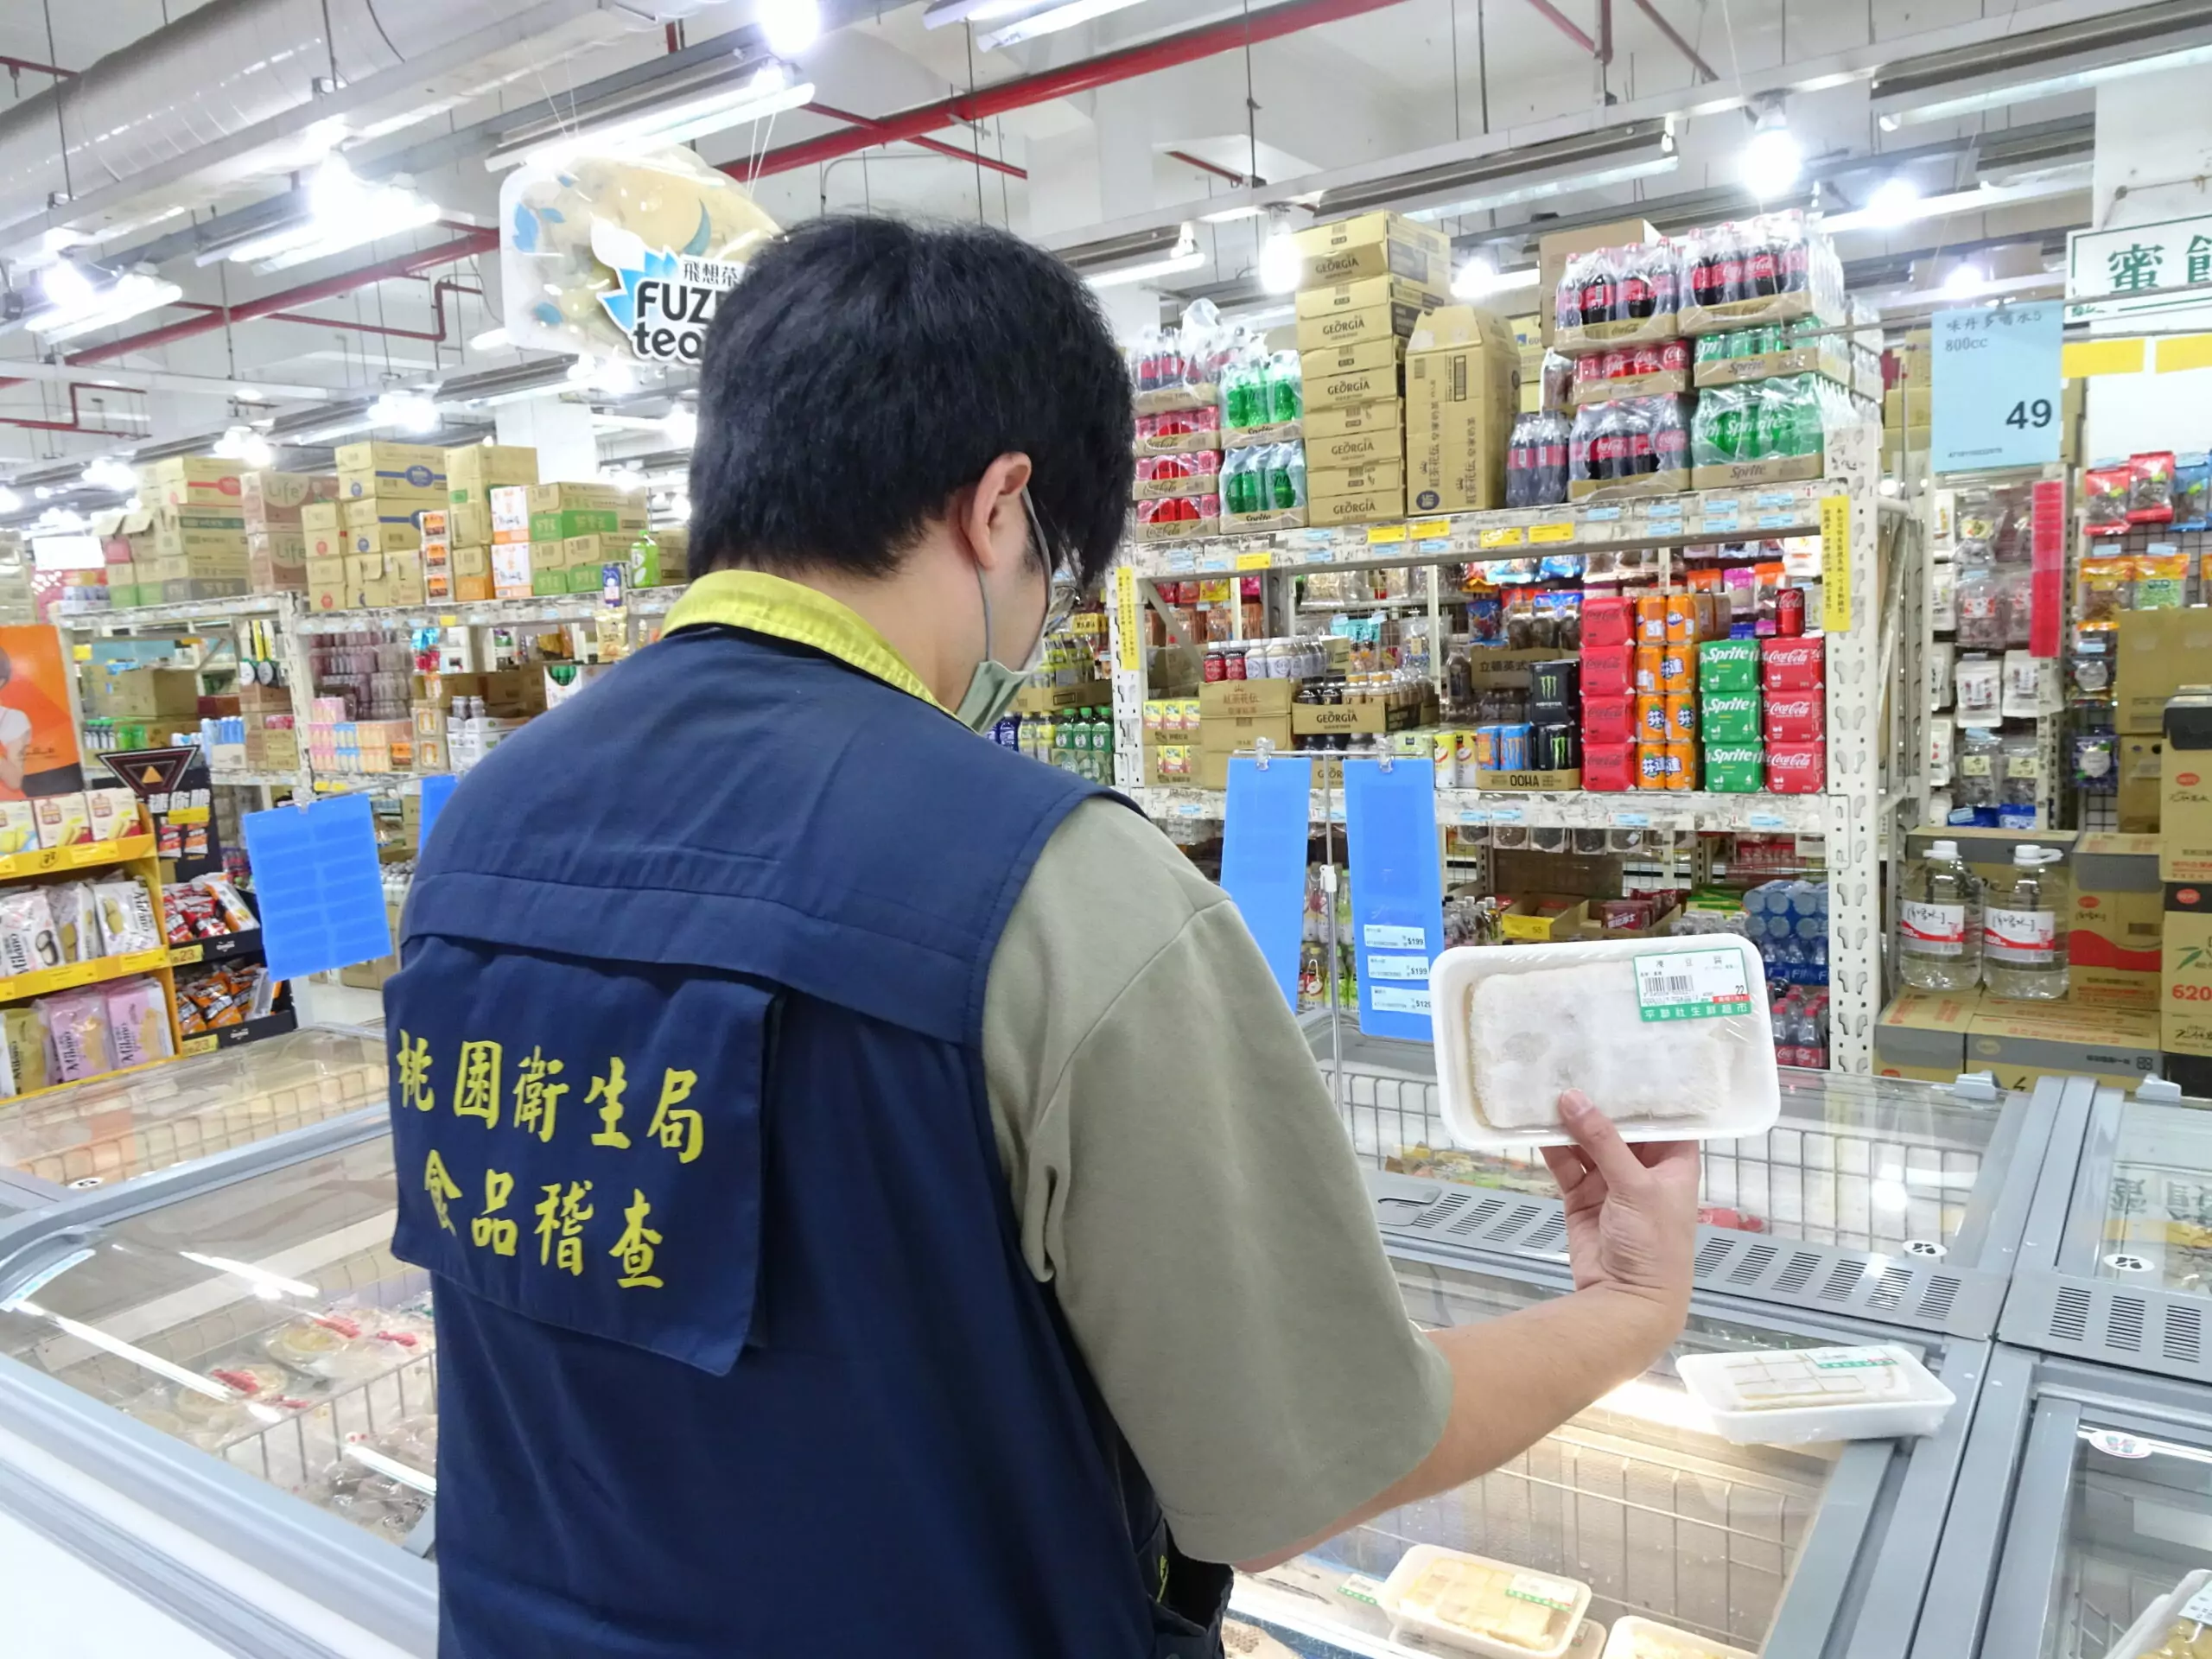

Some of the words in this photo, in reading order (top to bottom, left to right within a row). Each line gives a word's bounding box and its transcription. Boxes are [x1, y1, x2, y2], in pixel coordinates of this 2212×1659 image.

[683, 259, 739, 288] 飛想茶
[636, 280, 712, 324] FUZ
[1323, 318, 1365, 335] GEORGIA
[1945, 337, 1988, 352] 800cc
[1327, 380, 1370, 395] GEORGIA
[2005, 398, 2053, 429] 49
[1332, 440, 1375, 455] GEORGIA
[267, 480, 302, 509] Life
[1333, 499, 1376, 516] GEORGIA
[1707, 646, 1750, 664] Sprite
[1479, 659, 1529, 673] 立頓英式
[1709, 696, 1751, 713] Sprite
[1316, 710, 1358, 724] GEORGIA
[1712, 747, 1753, 764] Sprite
[1510, 775, 1540, 787] OOHA
[1408, 938, 1424, 946] $199
[1735, 984, 1745, 995] 22
[396, 1028, 704, 1164] 桃園衛生局
[424, 1149, 664, 1288] 食品稽查
